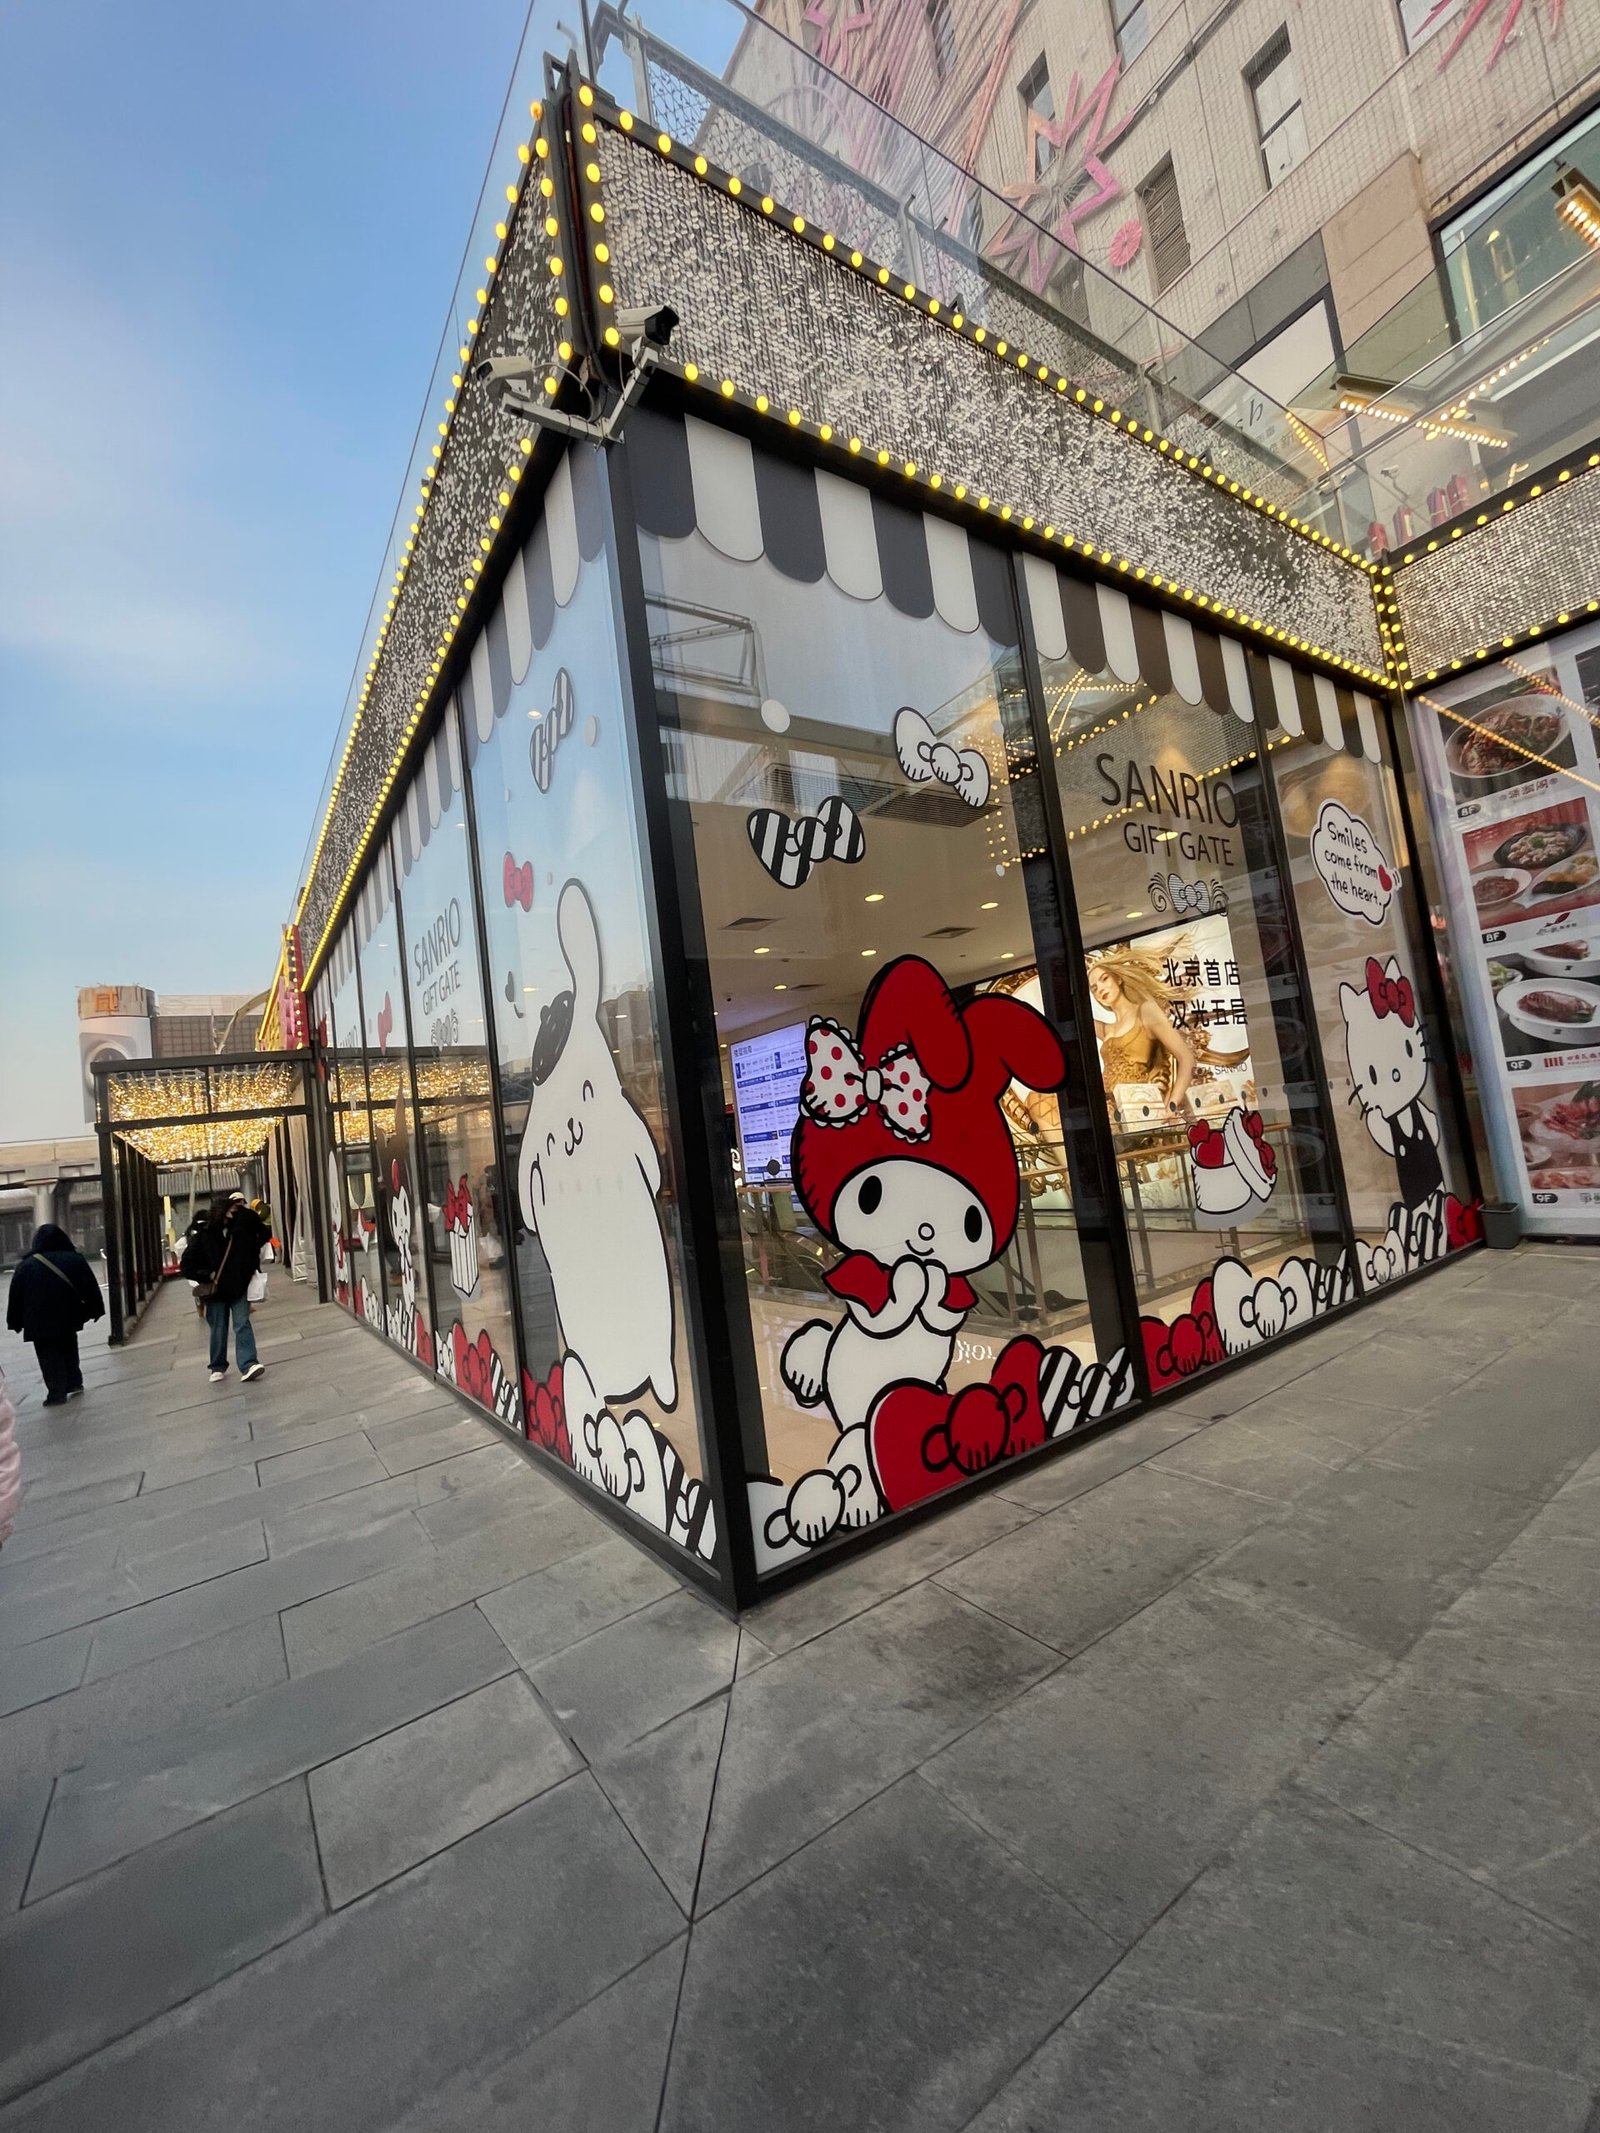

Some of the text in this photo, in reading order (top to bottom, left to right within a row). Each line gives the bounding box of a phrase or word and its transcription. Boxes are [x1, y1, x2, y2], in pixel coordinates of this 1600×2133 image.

[1096, 752, 1240, 828] SANRIO
[1124, 822, 1234, 866] GIFT GATE
[1327, 821, 1368, 854] Smiles
[1325, 849, 1378, 880] come from
[1331, 871, 1382, 906] the heart.
[413, 897, 461, 986] SANRIO
[422, 960, 461, 1016] GIFT GATE
[1162, 957, 1241, 987] 北京首店
[1168, 998, 1248, 1030] 汉光五层
